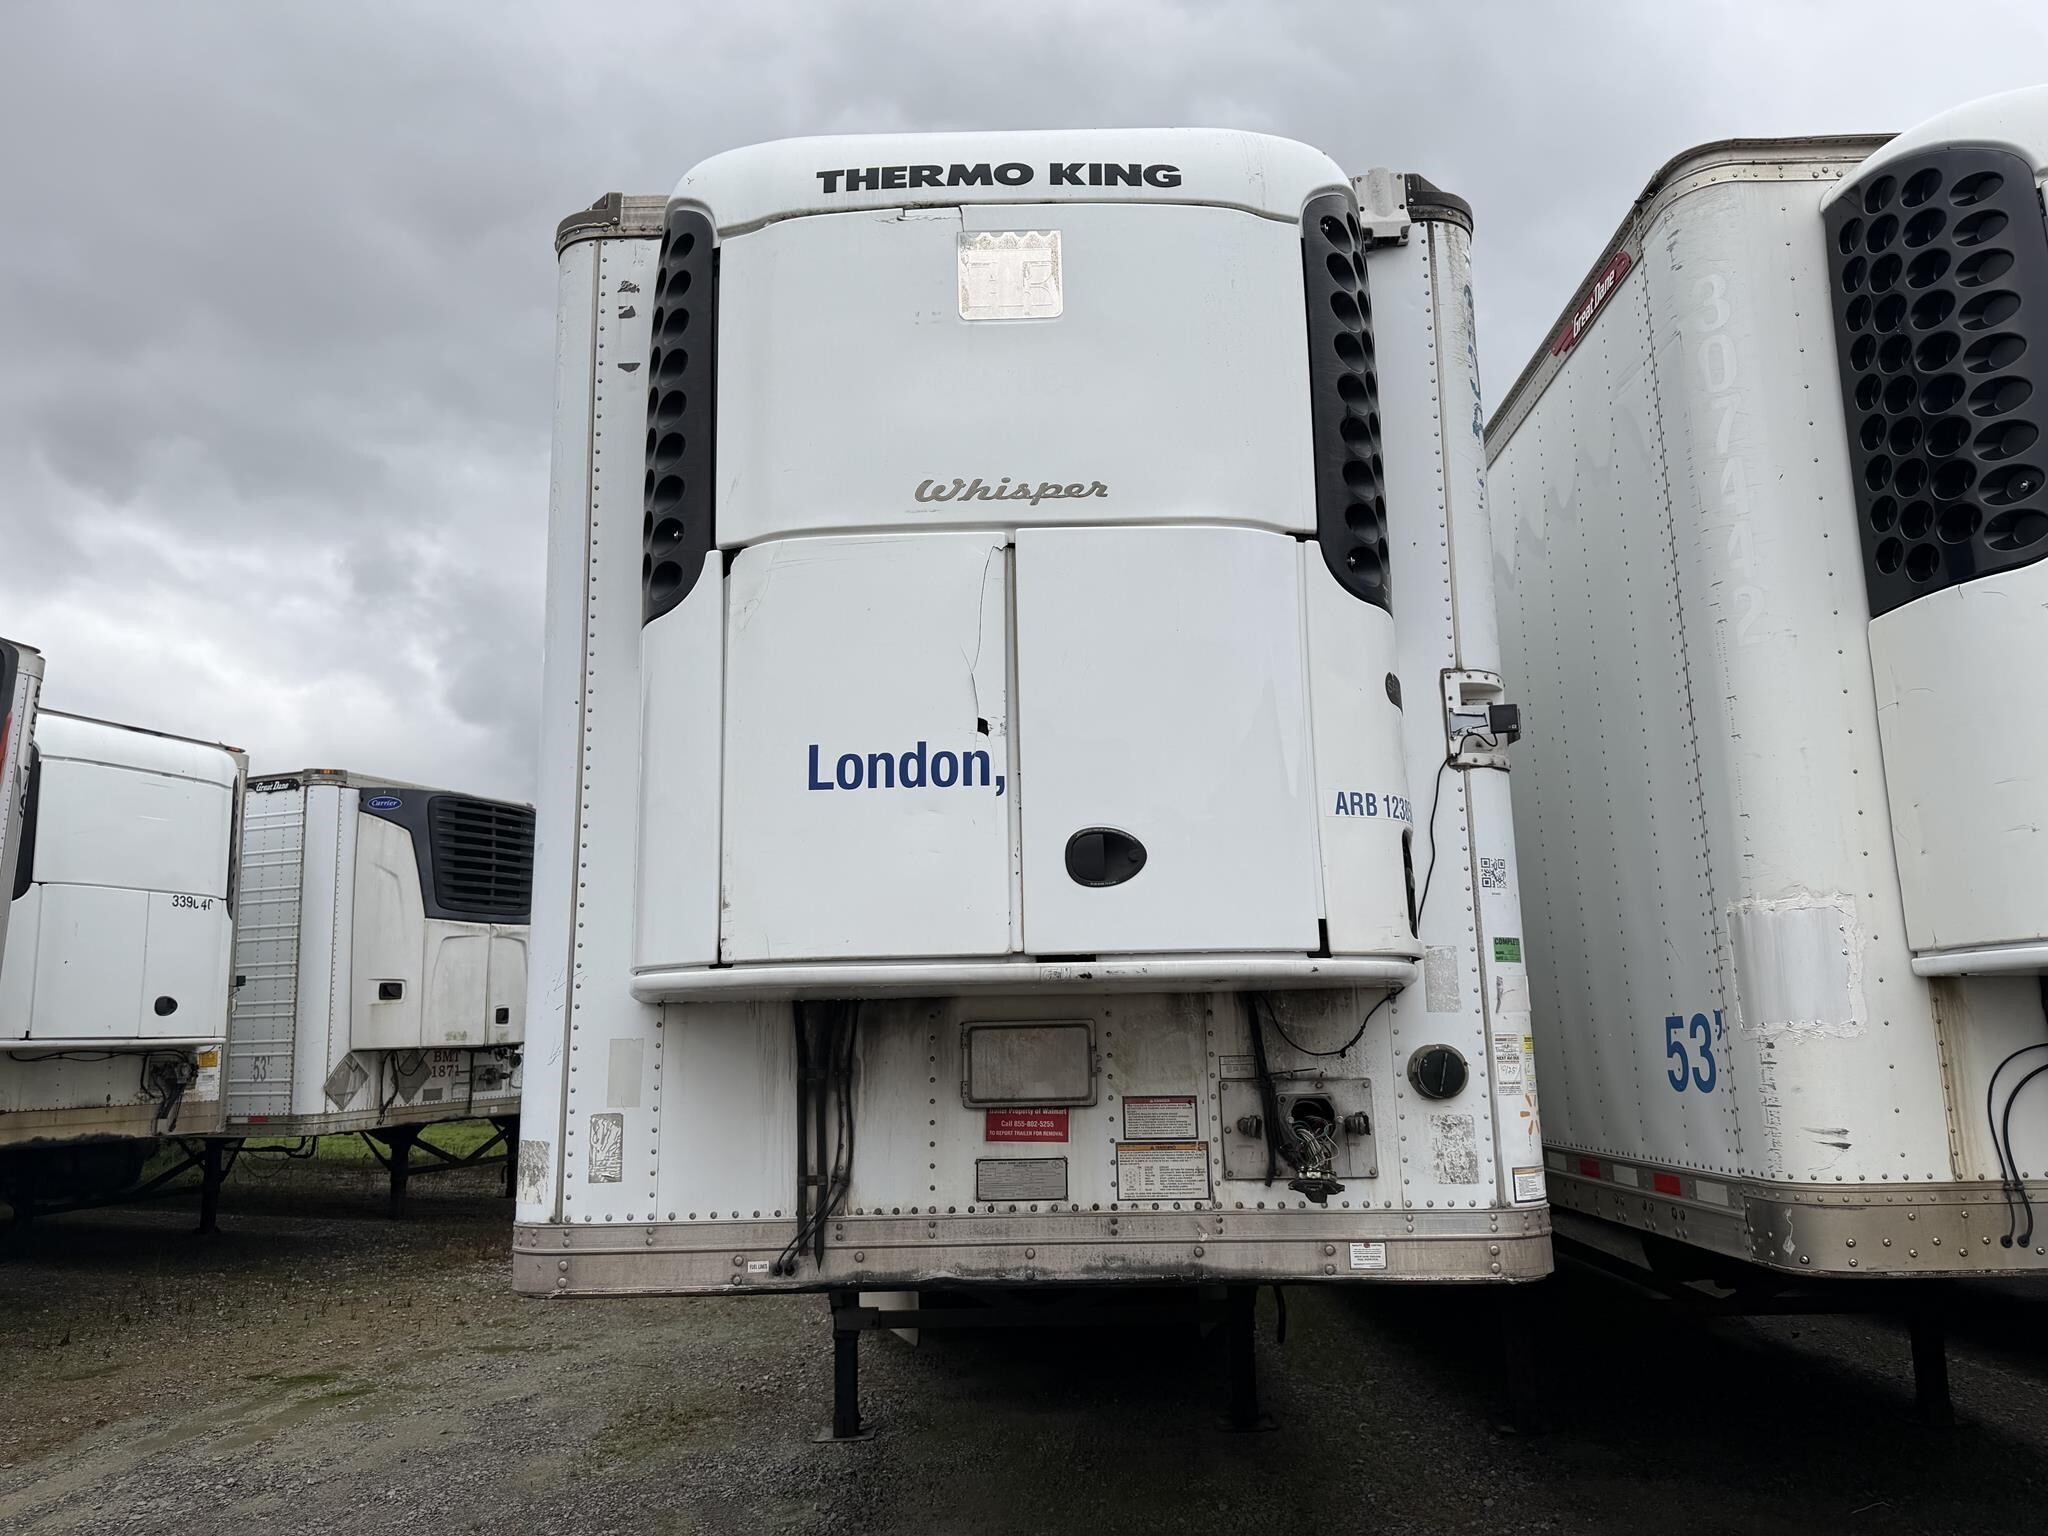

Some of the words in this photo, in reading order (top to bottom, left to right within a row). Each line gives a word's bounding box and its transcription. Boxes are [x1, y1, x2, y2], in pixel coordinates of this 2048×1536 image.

[816, 162, 1034, 193] THERMO
[1049, 162, 1182, 188] KING
[1573, 297, 1594, 338] Great
[1593, 270, 1615, 309] Dane
[914, 477, 1108, 506] Whisper
[808, 741, 1005, 796] London,
[255, 782, 272, 792] Great
[272, 781, 289, 790] Dane
[371, 799, 397, 807] Carrier
[1335, 791, 1378, 816] ARB
[433, 1051, 460, 1063] BMT
[431, 1064, 460, 1078] 1871
